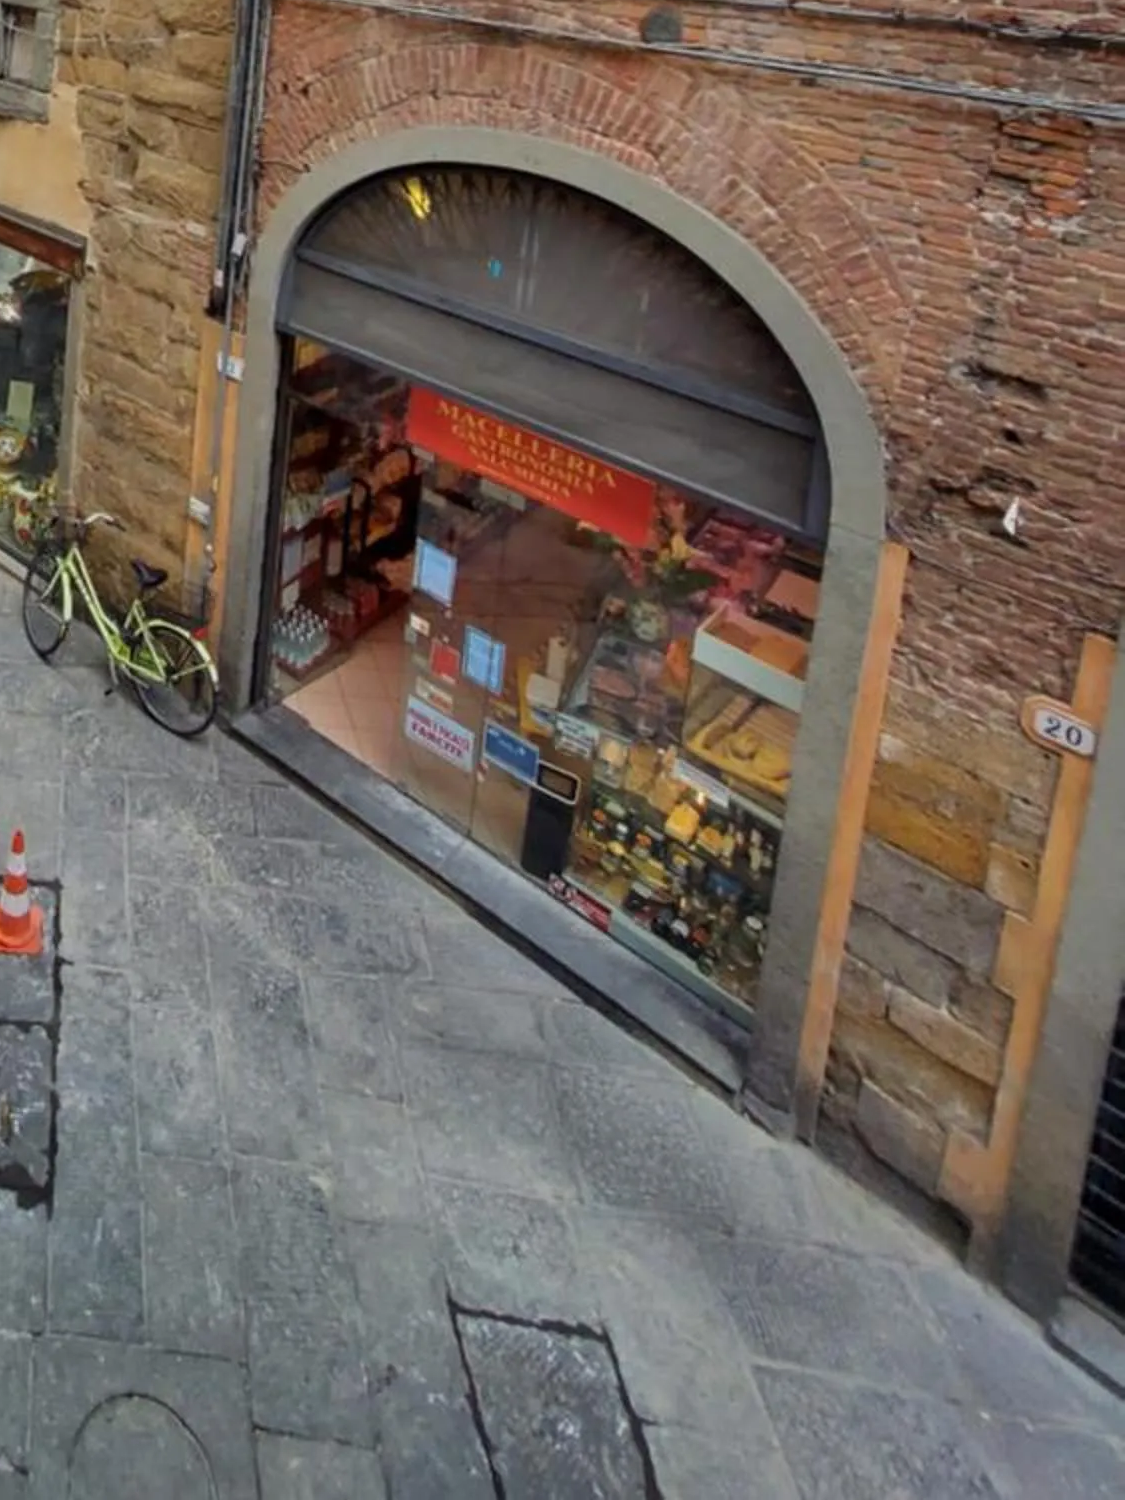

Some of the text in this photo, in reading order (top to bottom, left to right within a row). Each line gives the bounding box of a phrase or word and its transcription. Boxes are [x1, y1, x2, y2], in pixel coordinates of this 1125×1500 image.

[436, 399, 617, 489] MACELLERIA
[451, 423, 595, 495] GASTRONOMIA
[1043, 716, 1083, 747] 20
